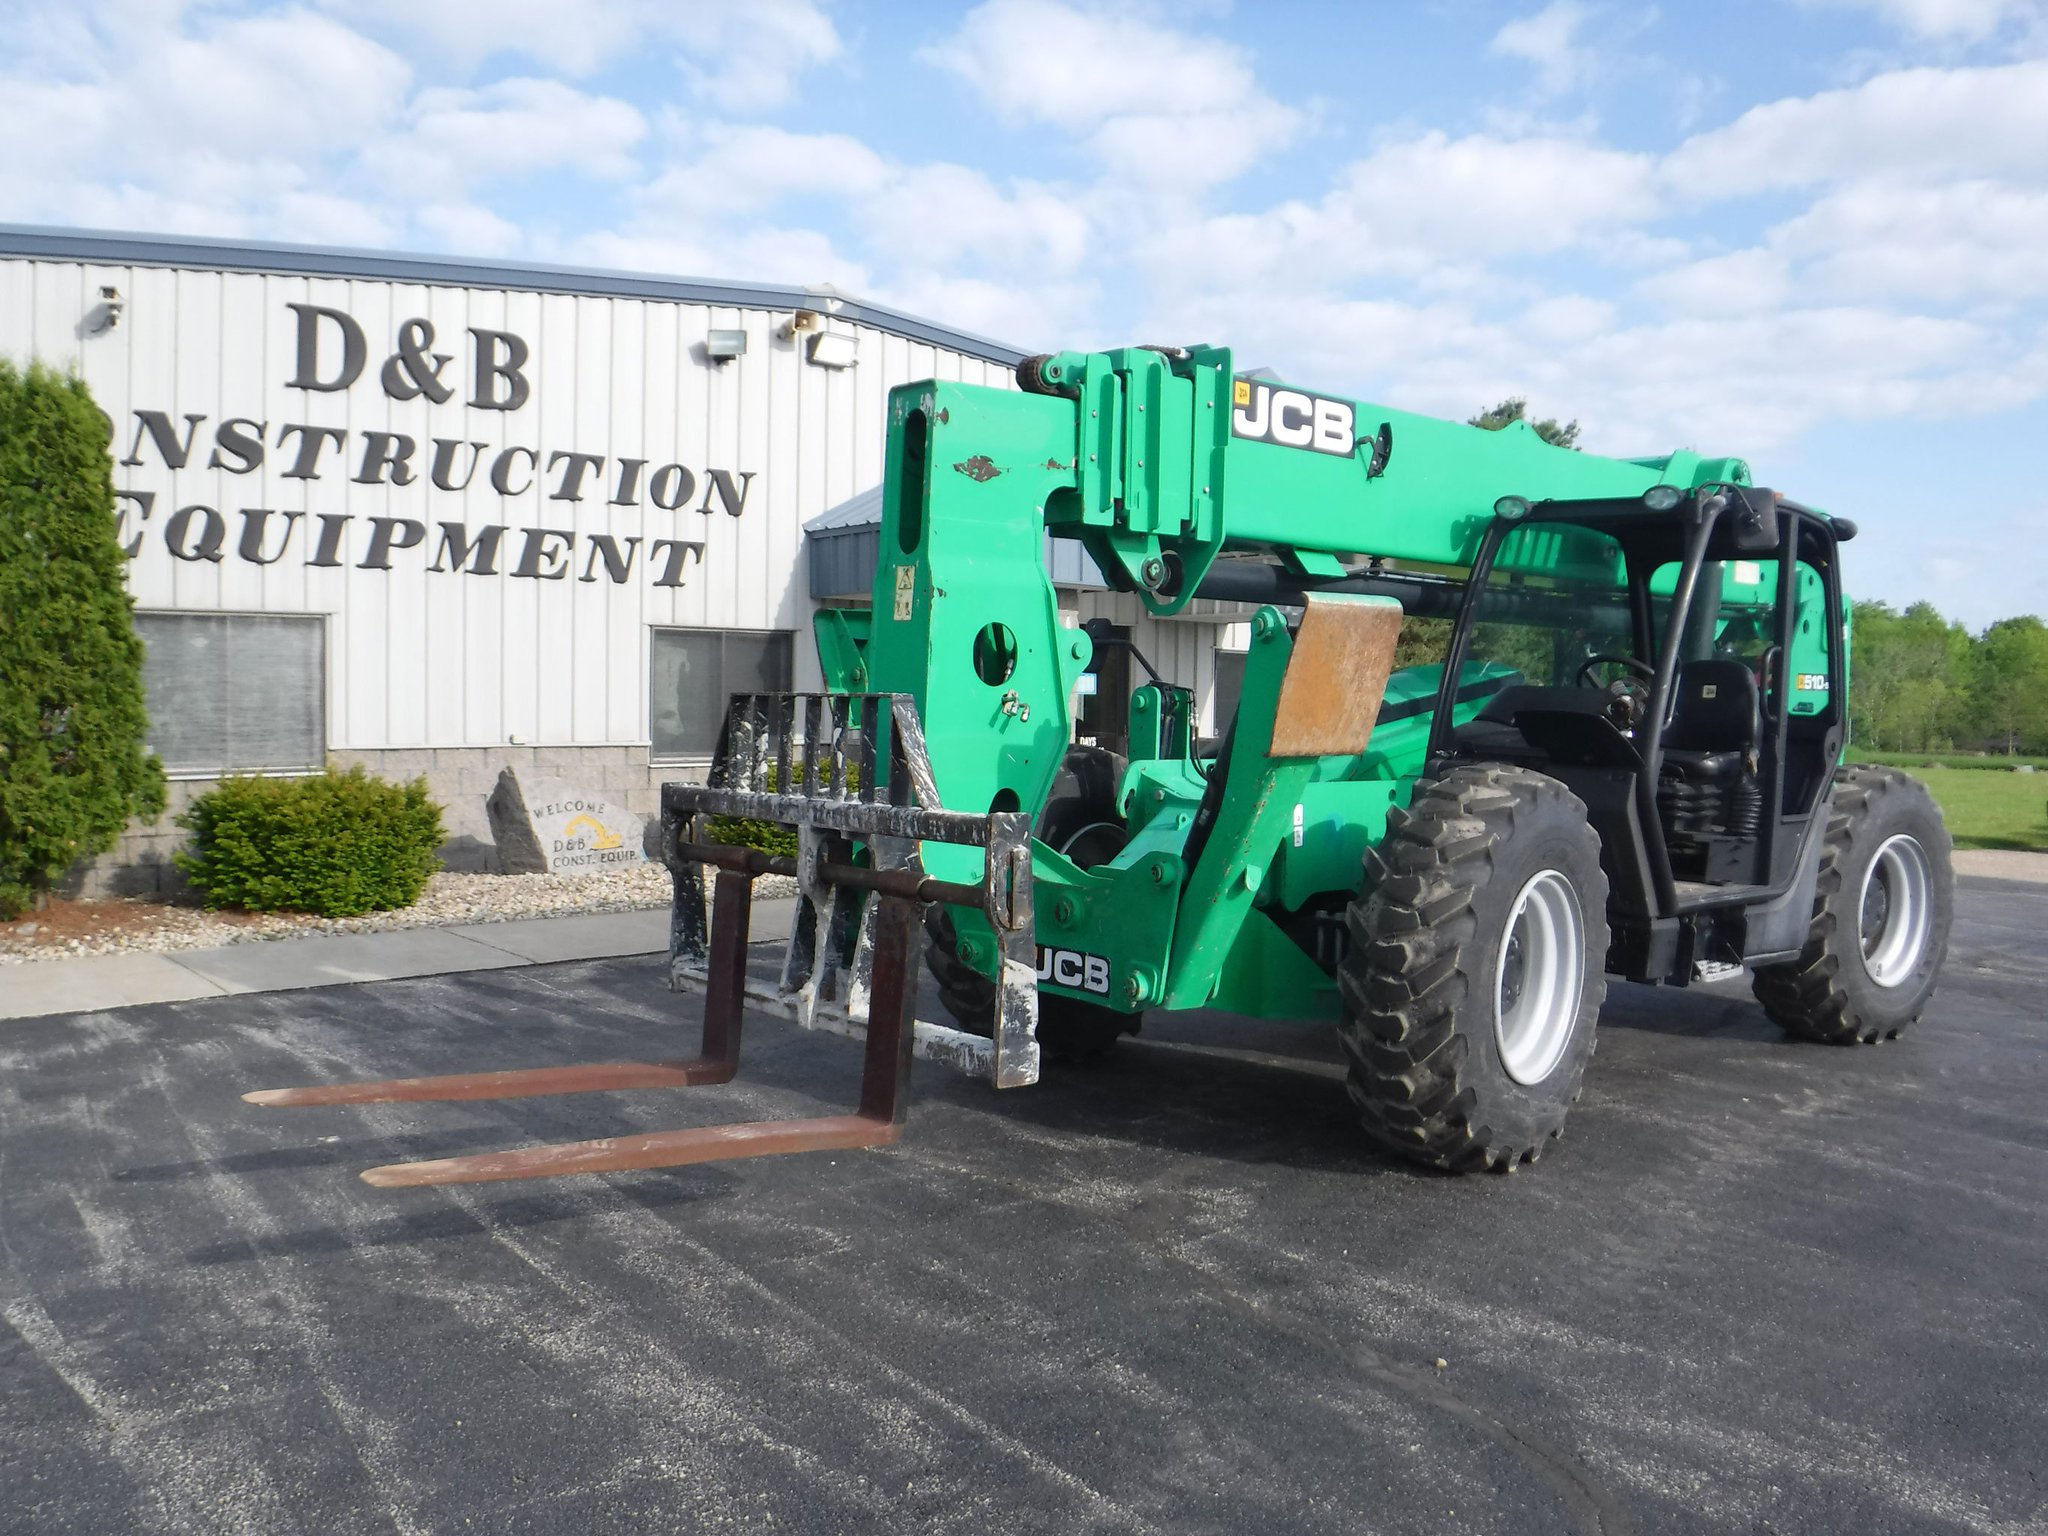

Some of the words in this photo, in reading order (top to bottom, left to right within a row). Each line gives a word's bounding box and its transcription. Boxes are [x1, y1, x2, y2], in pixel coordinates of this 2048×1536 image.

[285, 303, 531, 411] D&B
[1233, 385, 1354, 453] JCB
[97, 404, 757, 517] NSTRUCTION
[533, 800, 606, 819] WELCOME
[553, 838, 586, 852] D&B
[553, 855, 596, 868] CONST.
[600, 850, 638, 863] EQUIP.
[1036, 947, 1109, 993] JCB
